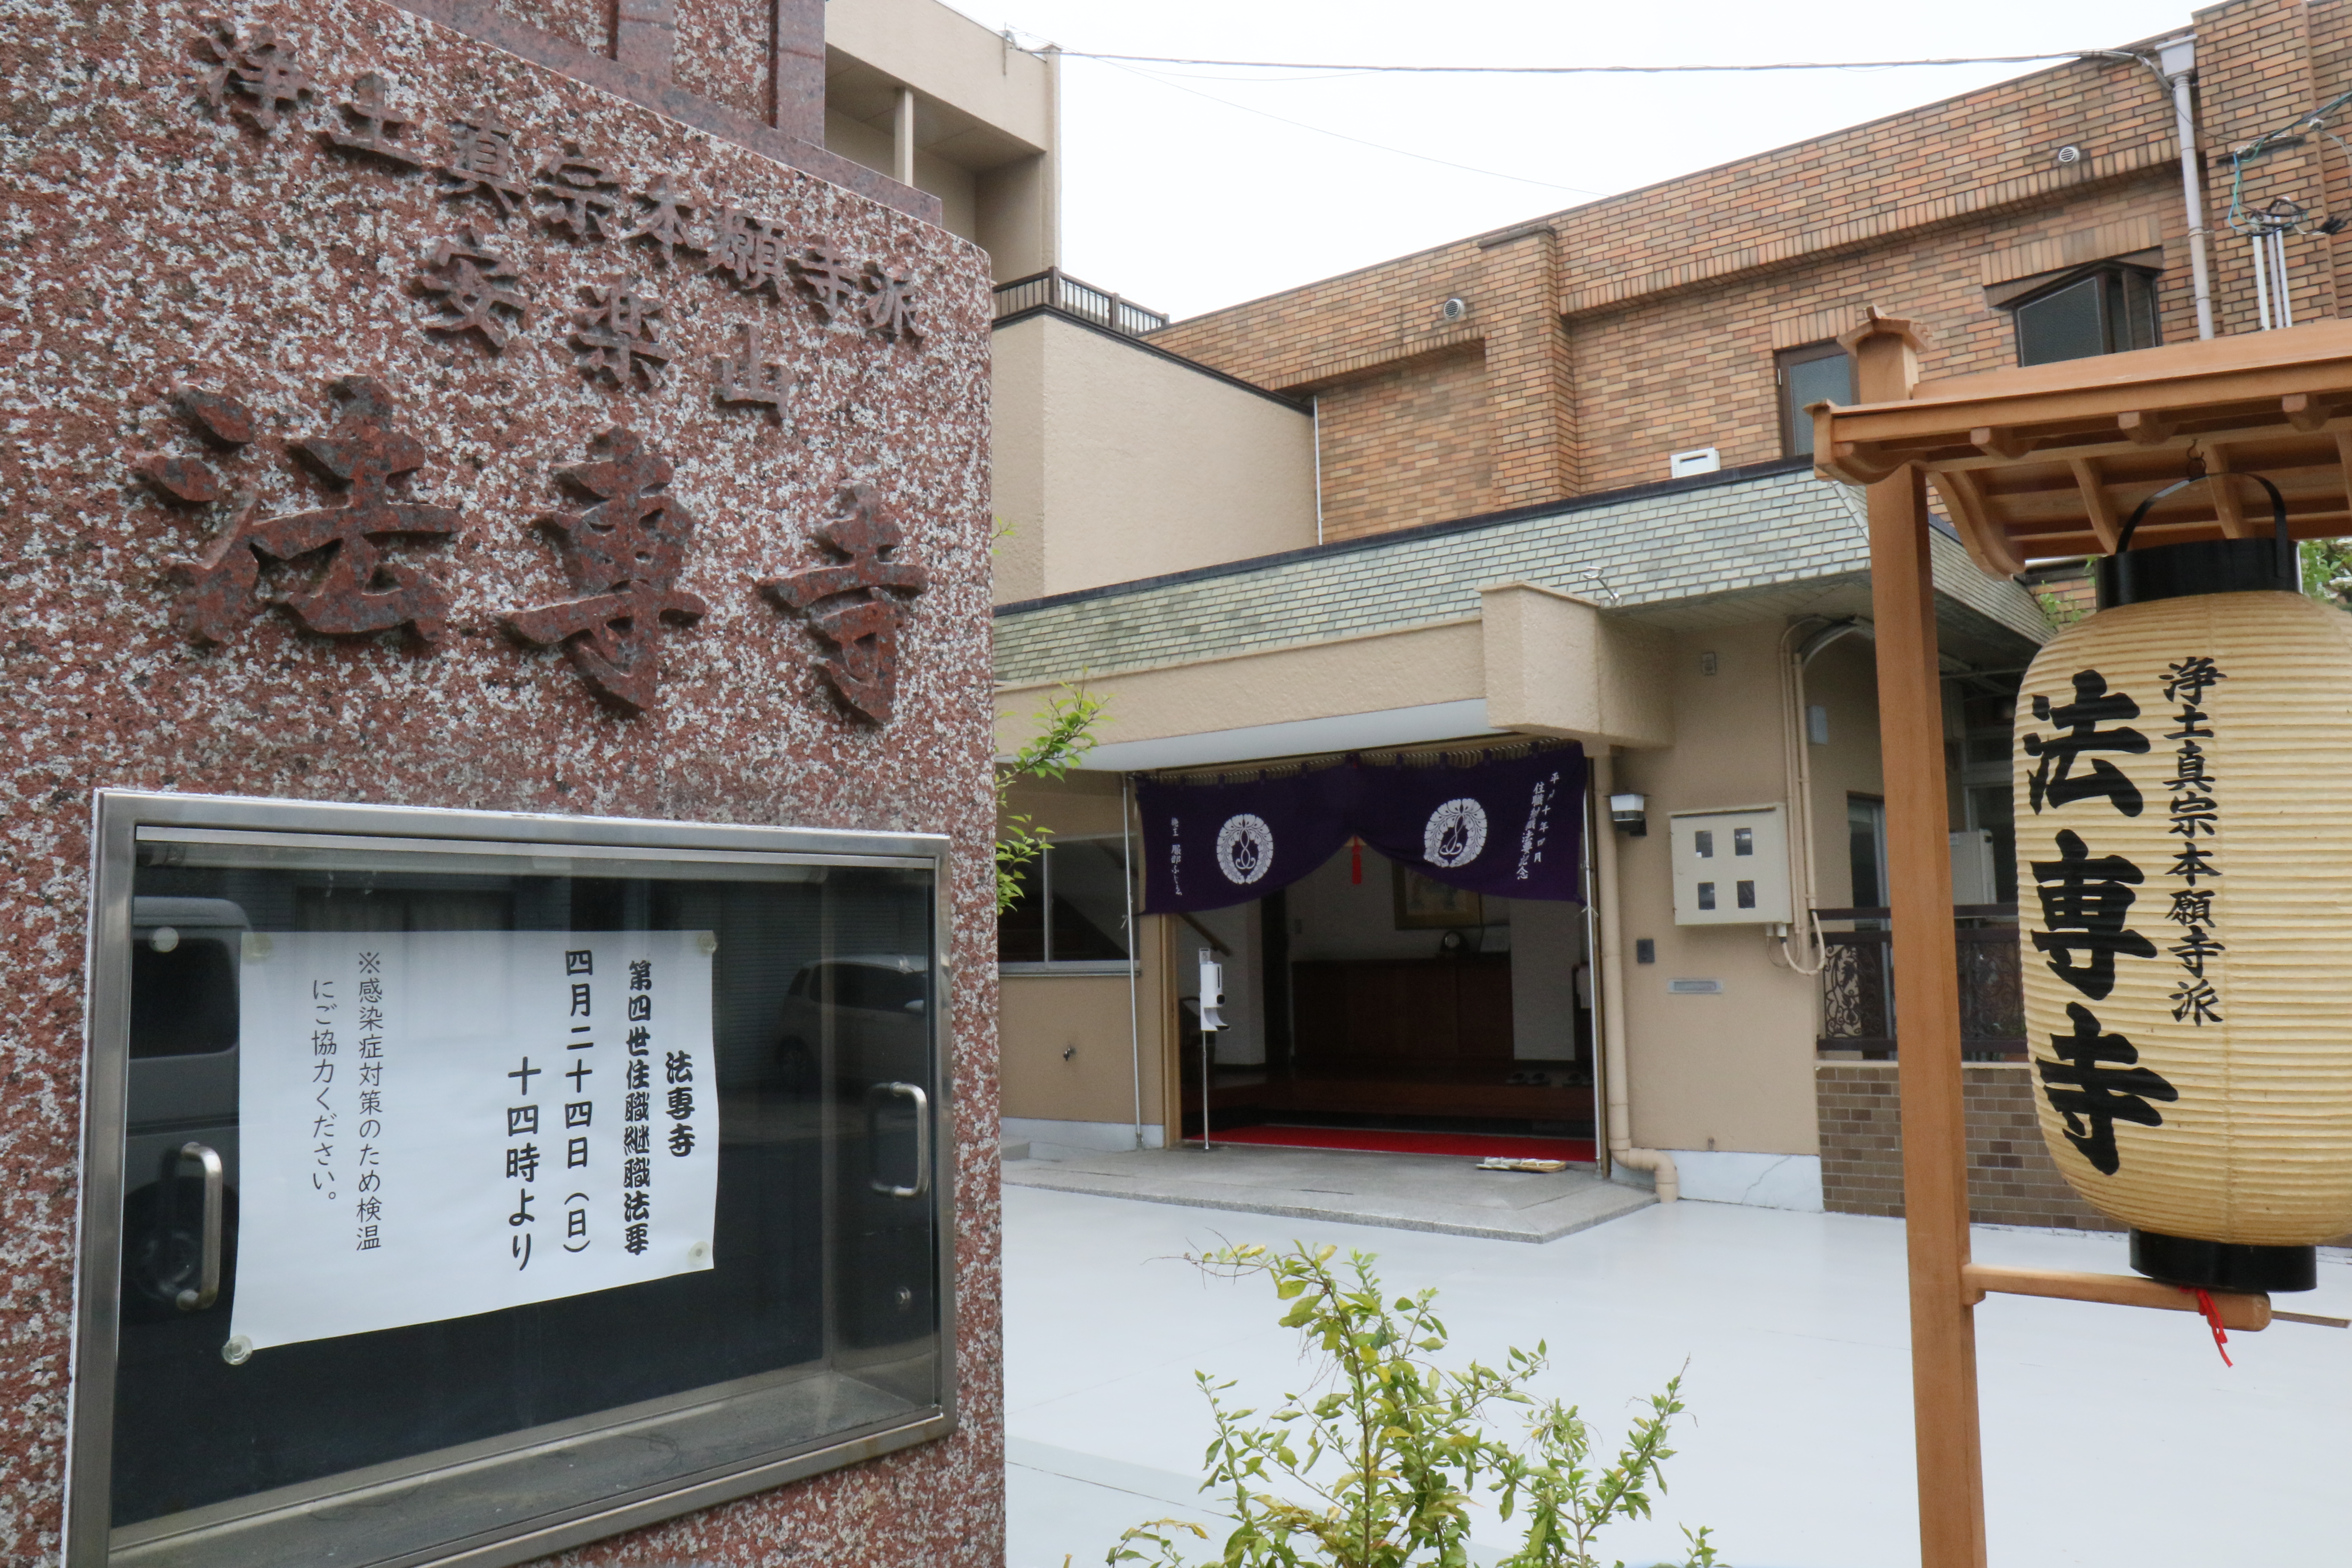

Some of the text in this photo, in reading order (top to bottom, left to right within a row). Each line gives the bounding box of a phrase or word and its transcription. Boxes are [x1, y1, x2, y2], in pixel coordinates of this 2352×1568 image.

[196, 19, 927, 347] 浄土真宗本願寺派
[419, 226, 792, 423] 安楽山
[133, 373, 928, 727] 法専寺
[2023, 668, 2179, 1176] 法専寺
[2159, 656, 2228, 1027] 浄土真宗本願寺派
[312, 979, 337, 1200] にご協力ください。
[356, 951, 384, 1251] ※感染症対策のため検温
[506, 1056, 542, 1271] 十四時より
[623, 960, 652, 1255] 第四世住職継職法要
[666, 1050, 695, 1158] 法専寺
